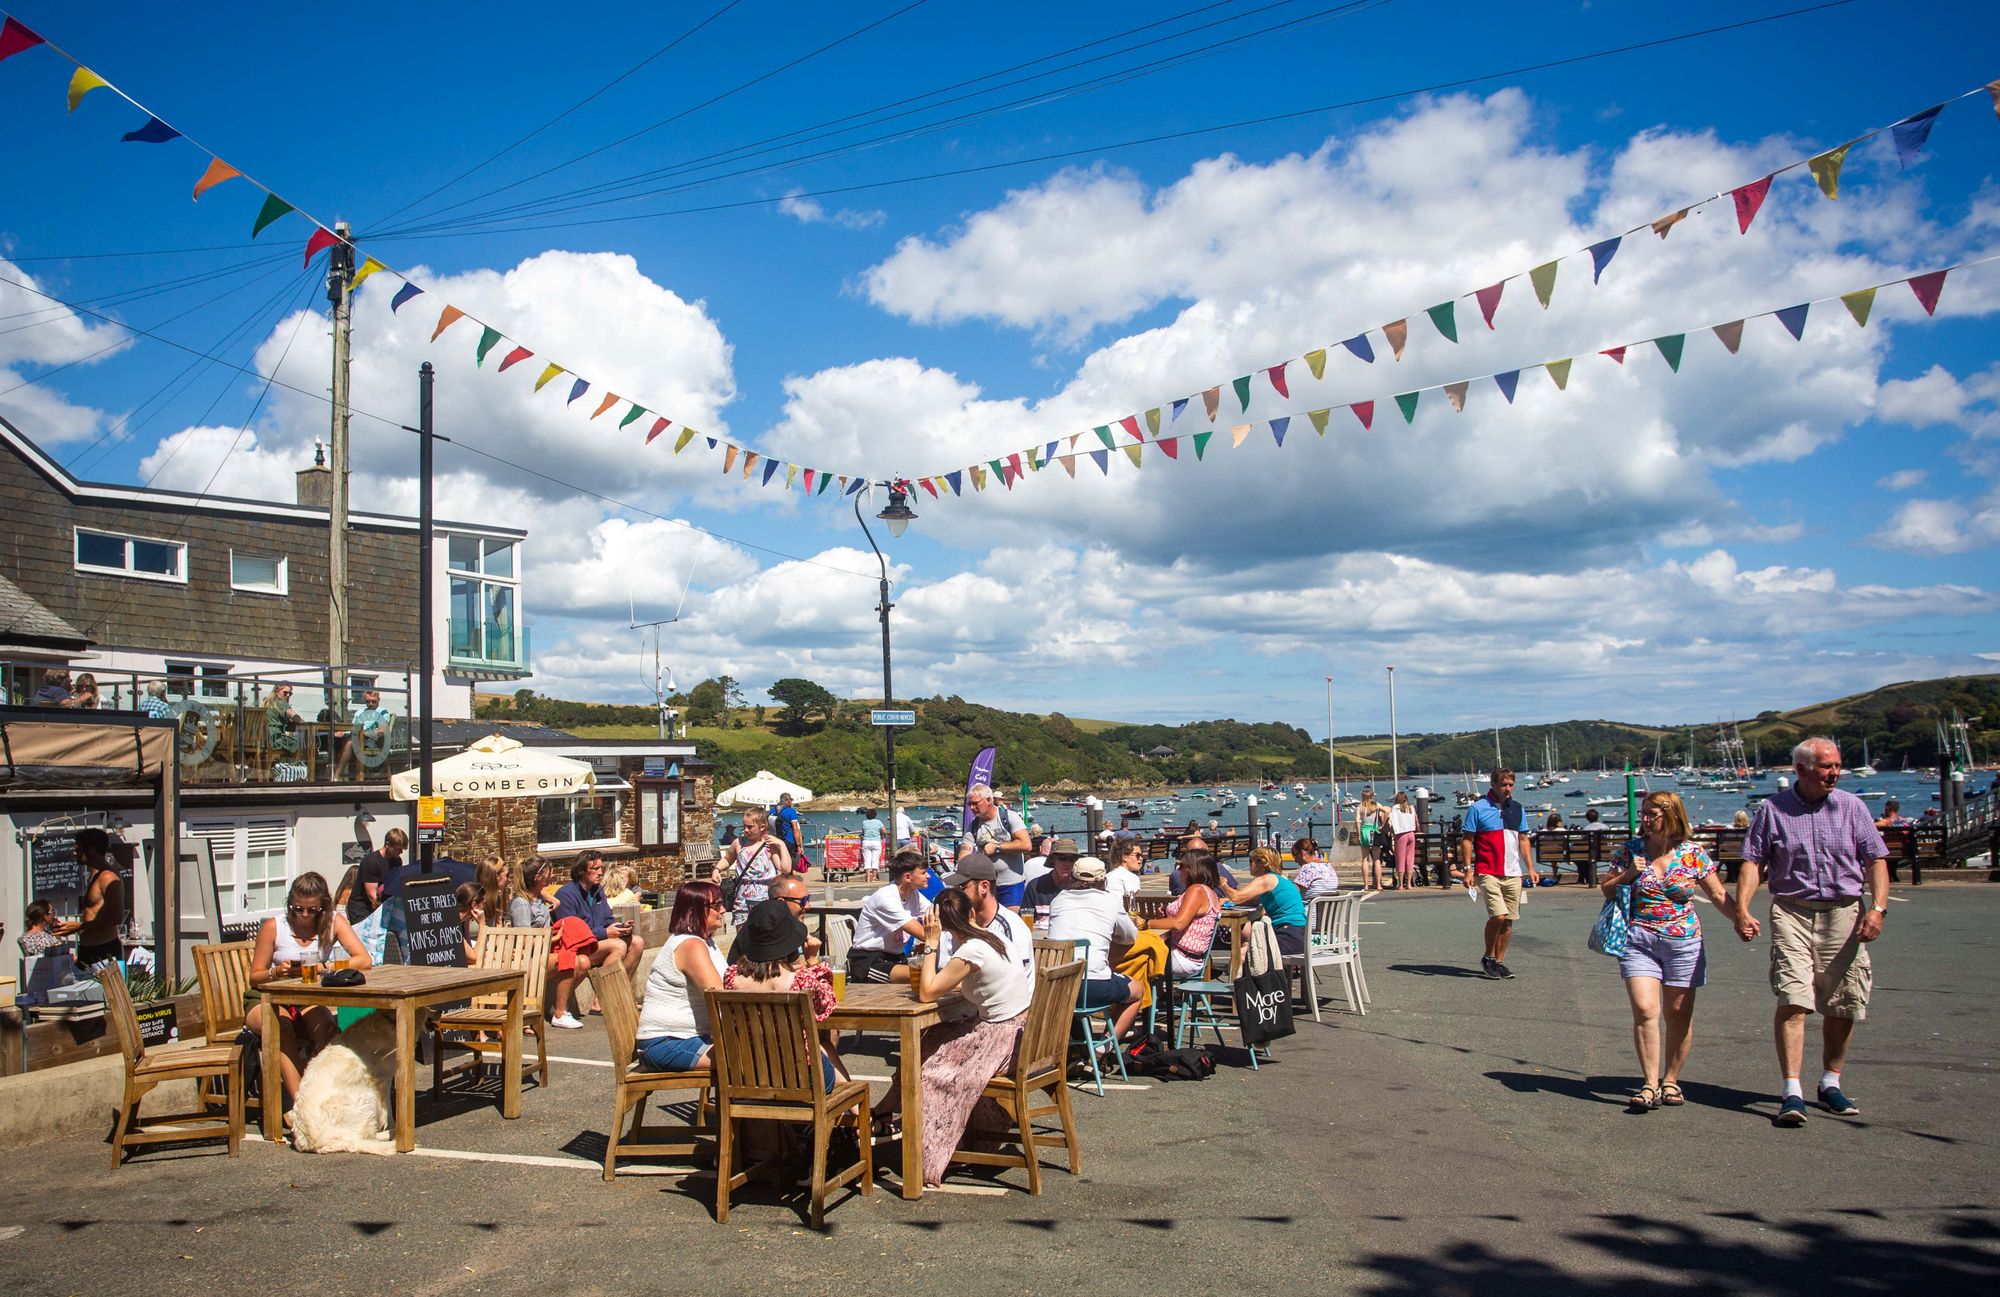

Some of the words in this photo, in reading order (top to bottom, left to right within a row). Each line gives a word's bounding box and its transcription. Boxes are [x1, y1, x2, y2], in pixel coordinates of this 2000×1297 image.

[410, 779, 525, 794] SLCOMBE
[538, 777, 573, 789] GIN
[407, 896, 430, 912] THESE
[431, 893, 457, 909] TABLES
[420, 912, 431, 925] ARE
[431, 911, 443, 923] FOR
[410, 929, 437, 951] KINGS
[439, 925, 463, 946] ARMS
[426, 948, 456, 965] DRINKING
[1245, 990, 1285, 1009] More
[1257, 1004, 1278, 1025] Joy
